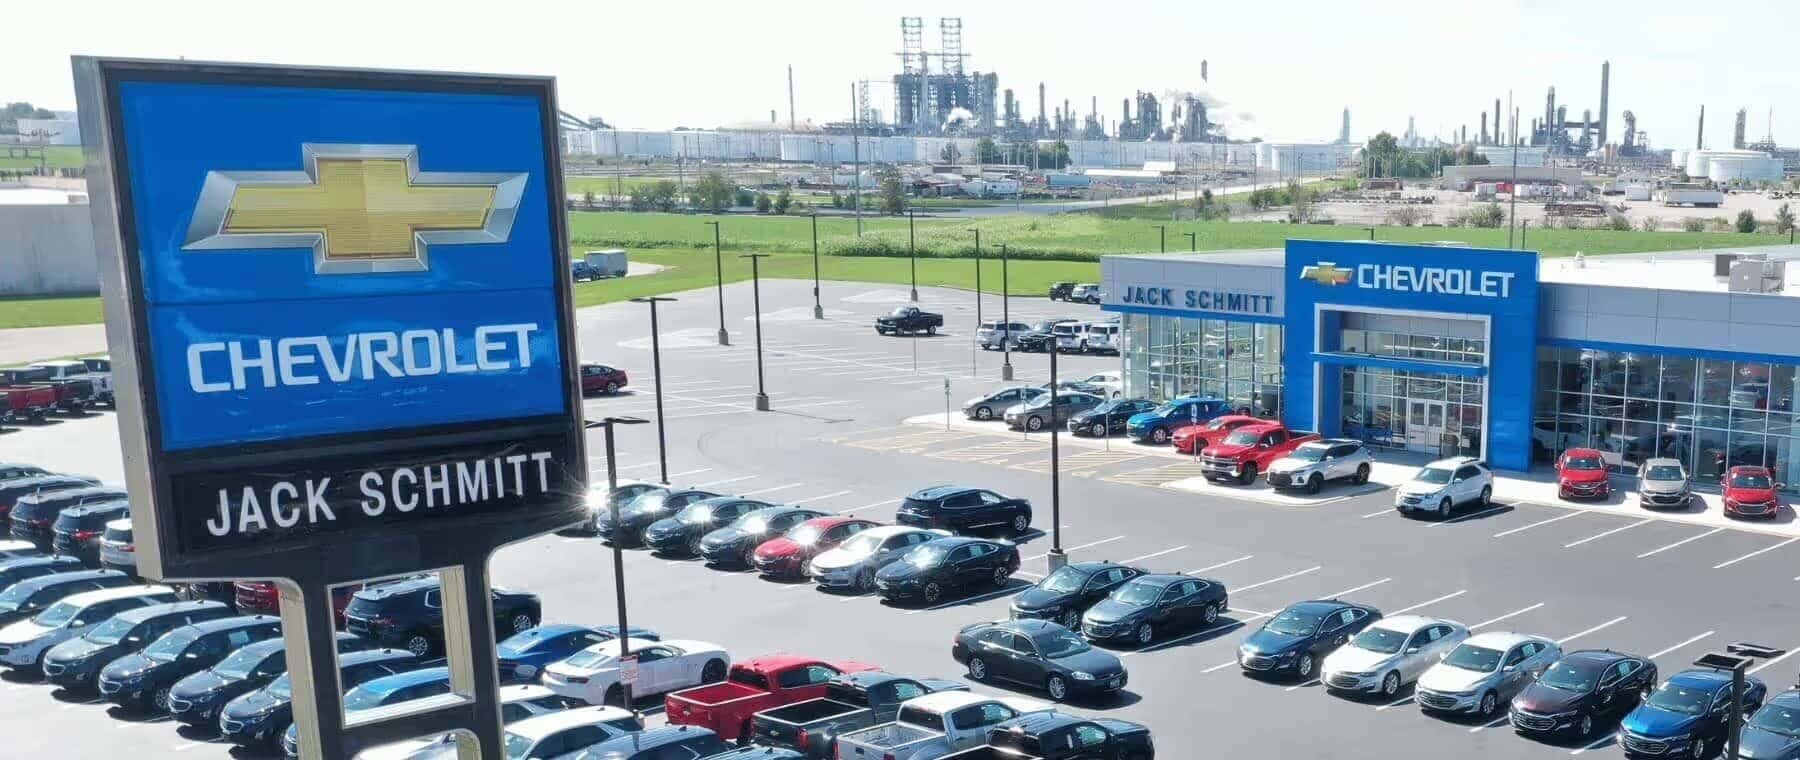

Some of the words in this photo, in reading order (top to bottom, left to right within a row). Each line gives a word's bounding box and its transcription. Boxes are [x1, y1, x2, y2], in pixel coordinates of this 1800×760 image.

[1122, 286, 1174, 306] JACK
[1184, 289, 1274, 314] SCHMITT
[1358, 264, 1514, 298] CHEVROLET
[187, 323, 538, 393] CHEVROLET
[207, 477, 336, 537] JACK
[359, 450, 552, 517] SCHMITT
